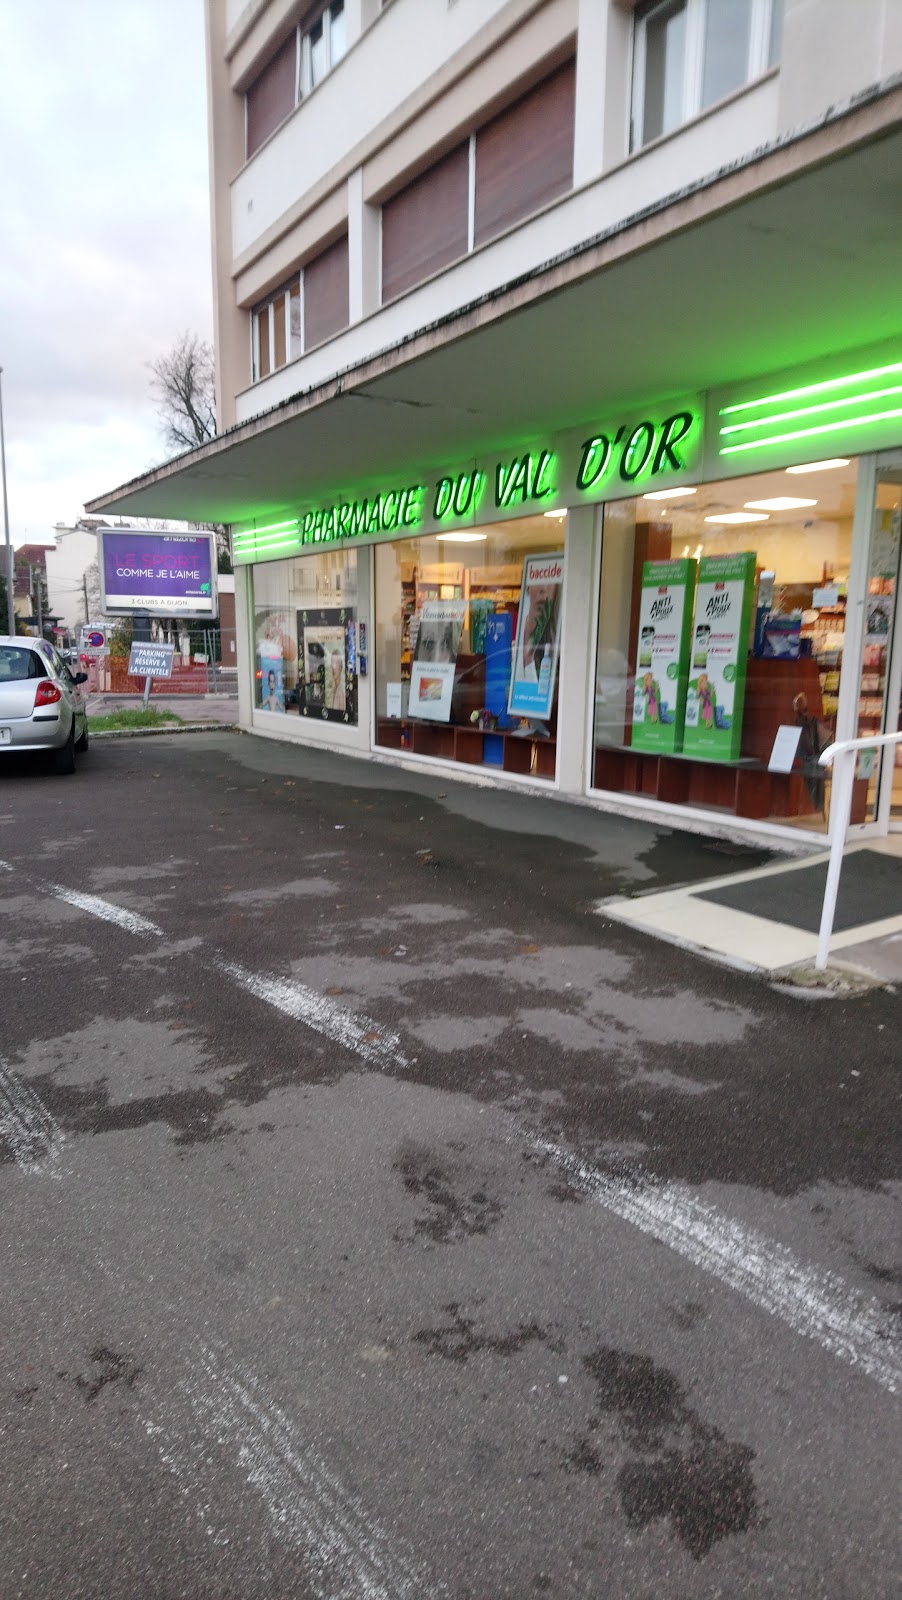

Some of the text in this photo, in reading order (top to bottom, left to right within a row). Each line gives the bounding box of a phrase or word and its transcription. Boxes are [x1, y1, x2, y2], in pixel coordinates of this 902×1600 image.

[302, 412, 692, 545] PHARMACIE DU VAL D'OR
[115, 553, 200, 569] LE SPORT
[116, 568, 200, 580] COMME JE L'AIME
[529, 561, 562, 580] baccide
[139, 649, 165, 658] PARKING
